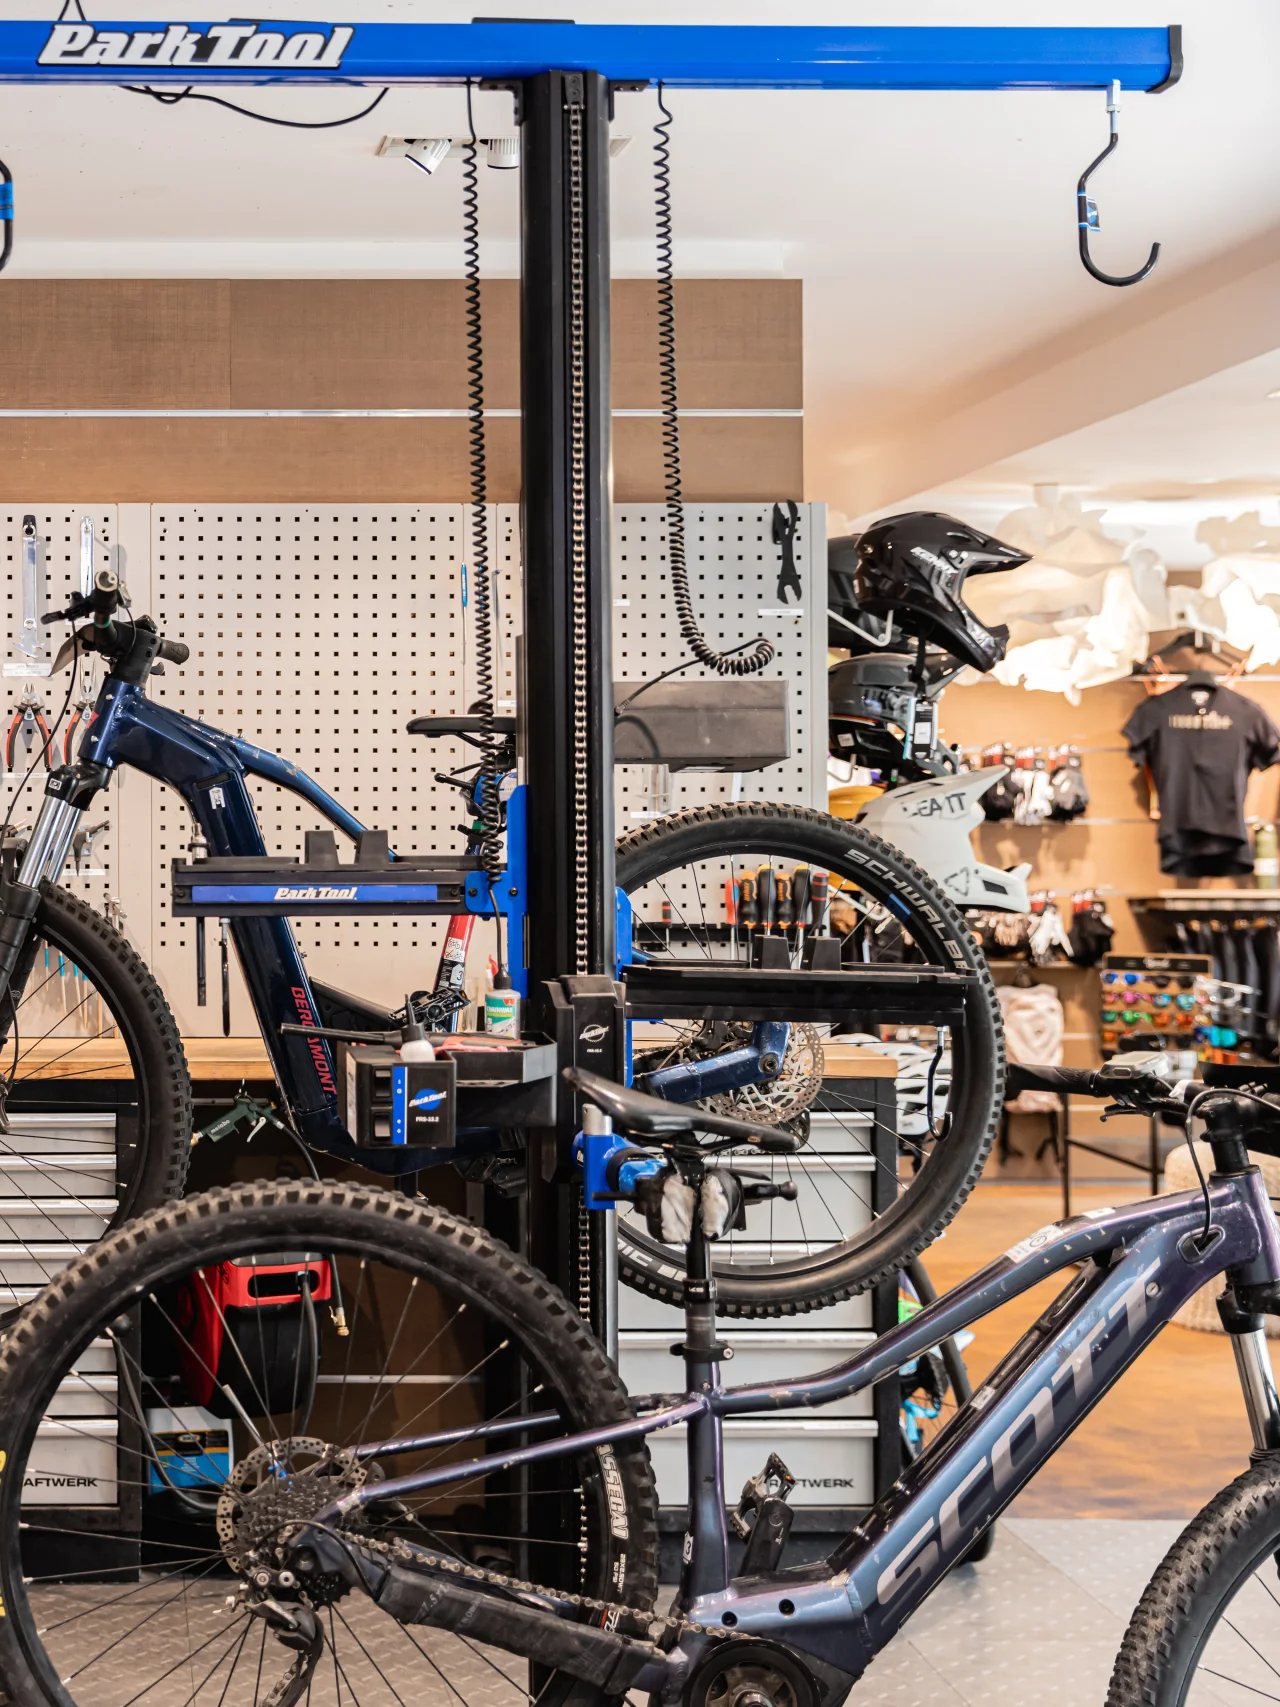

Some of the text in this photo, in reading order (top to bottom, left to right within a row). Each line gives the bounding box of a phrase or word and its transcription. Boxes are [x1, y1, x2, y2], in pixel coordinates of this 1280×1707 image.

[210, 1119, 230, 1134] metabo
[876, 1256, 1161, 1607] SCOTT
[23, 1477, 98, 1487] AFTWERK
